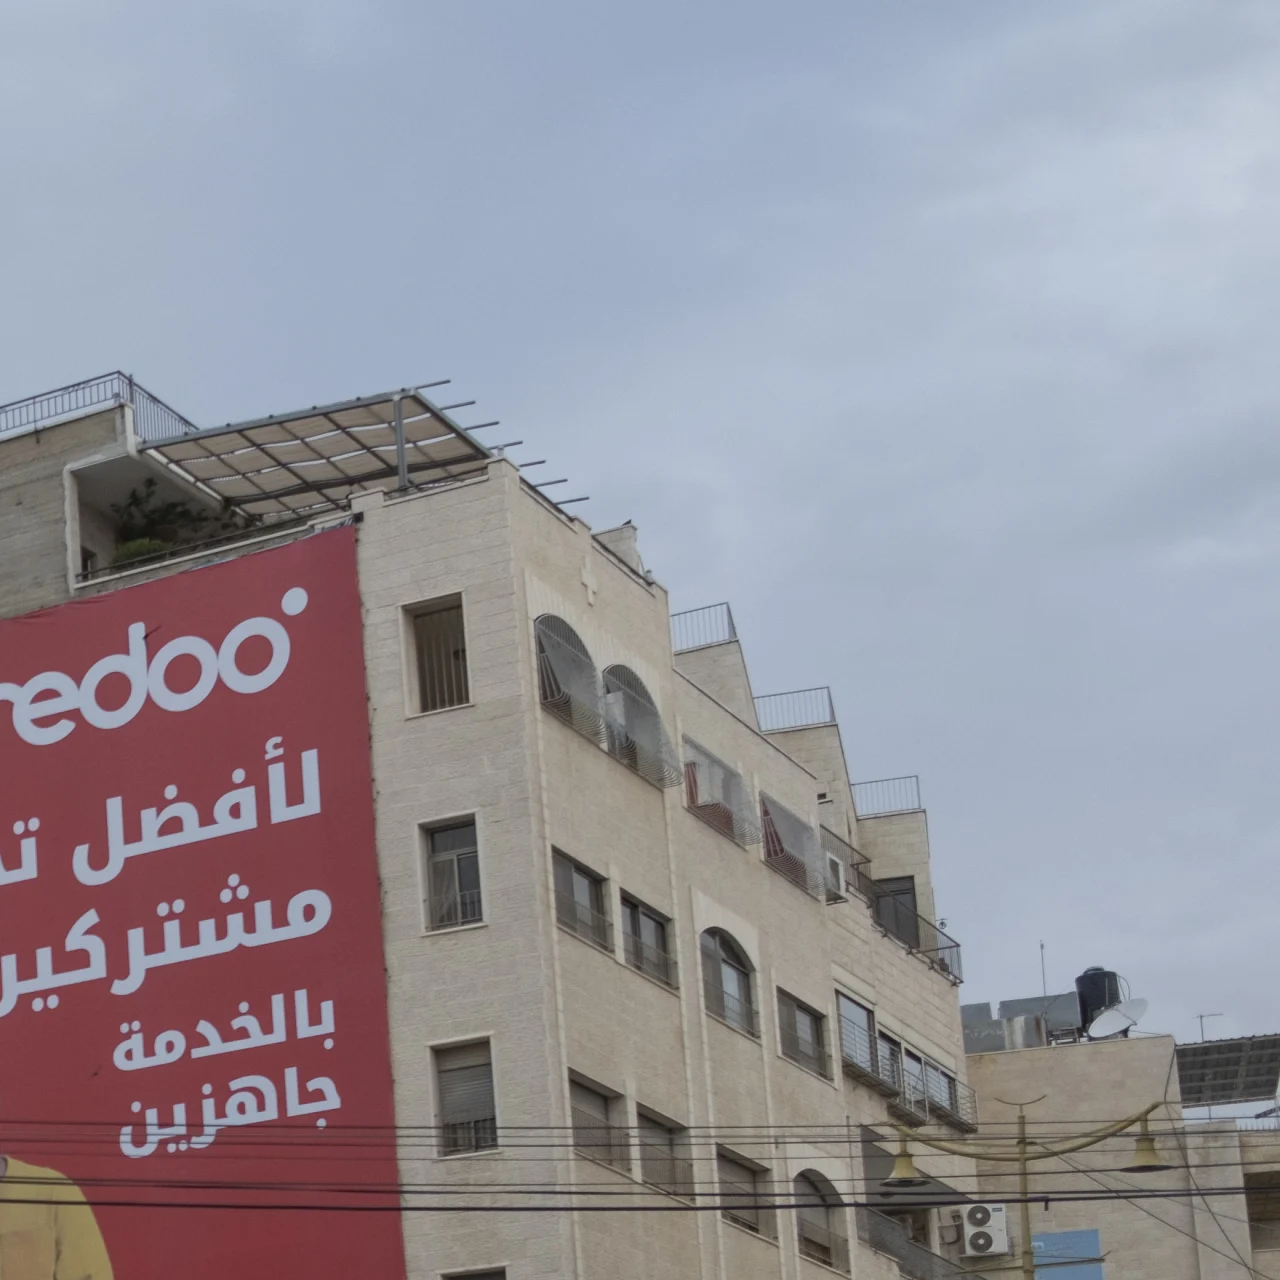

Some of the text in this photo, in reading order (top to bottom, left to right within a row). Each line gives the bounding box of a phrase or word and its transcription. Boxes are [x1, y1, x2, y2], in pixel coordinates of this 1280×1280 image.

[72, 736, 321, 886] لأفضل
[113, 988, 336, 1071] بالخدمة
[120, 1067, 342, 1158] جاهزين
